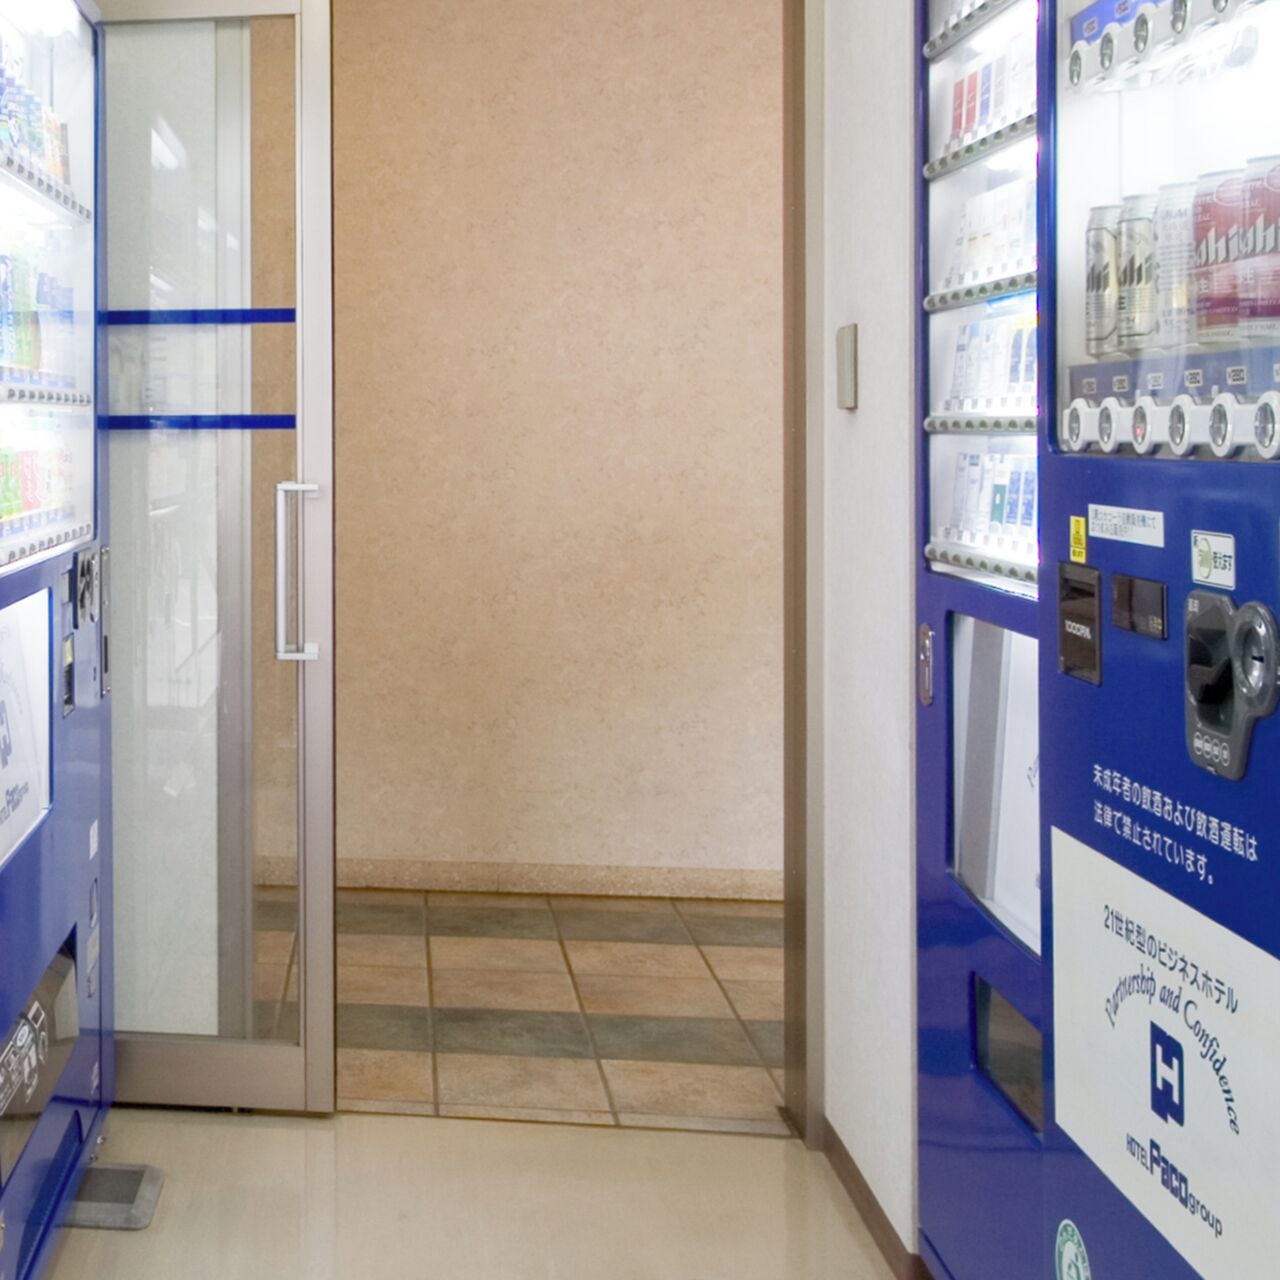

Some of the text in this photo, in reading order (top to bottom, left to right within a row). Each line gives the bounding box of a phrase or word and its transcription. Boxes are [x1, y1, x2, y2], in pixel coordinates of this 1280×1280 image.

[1093, 763, 1258, 862] 未成年者の飲酒および飲酒運転は
[1093, 800, 1214, 885] 法律で禁止されています。
[1104, 904, 1239, 1015] 21世紀型のビジネスホテル
[1105, 963, 1240, 1136] Partnership and Confidence
[1126, 1131, 1150, 1174] HOTEL
[1187, 1191, 1224, 1239] group
